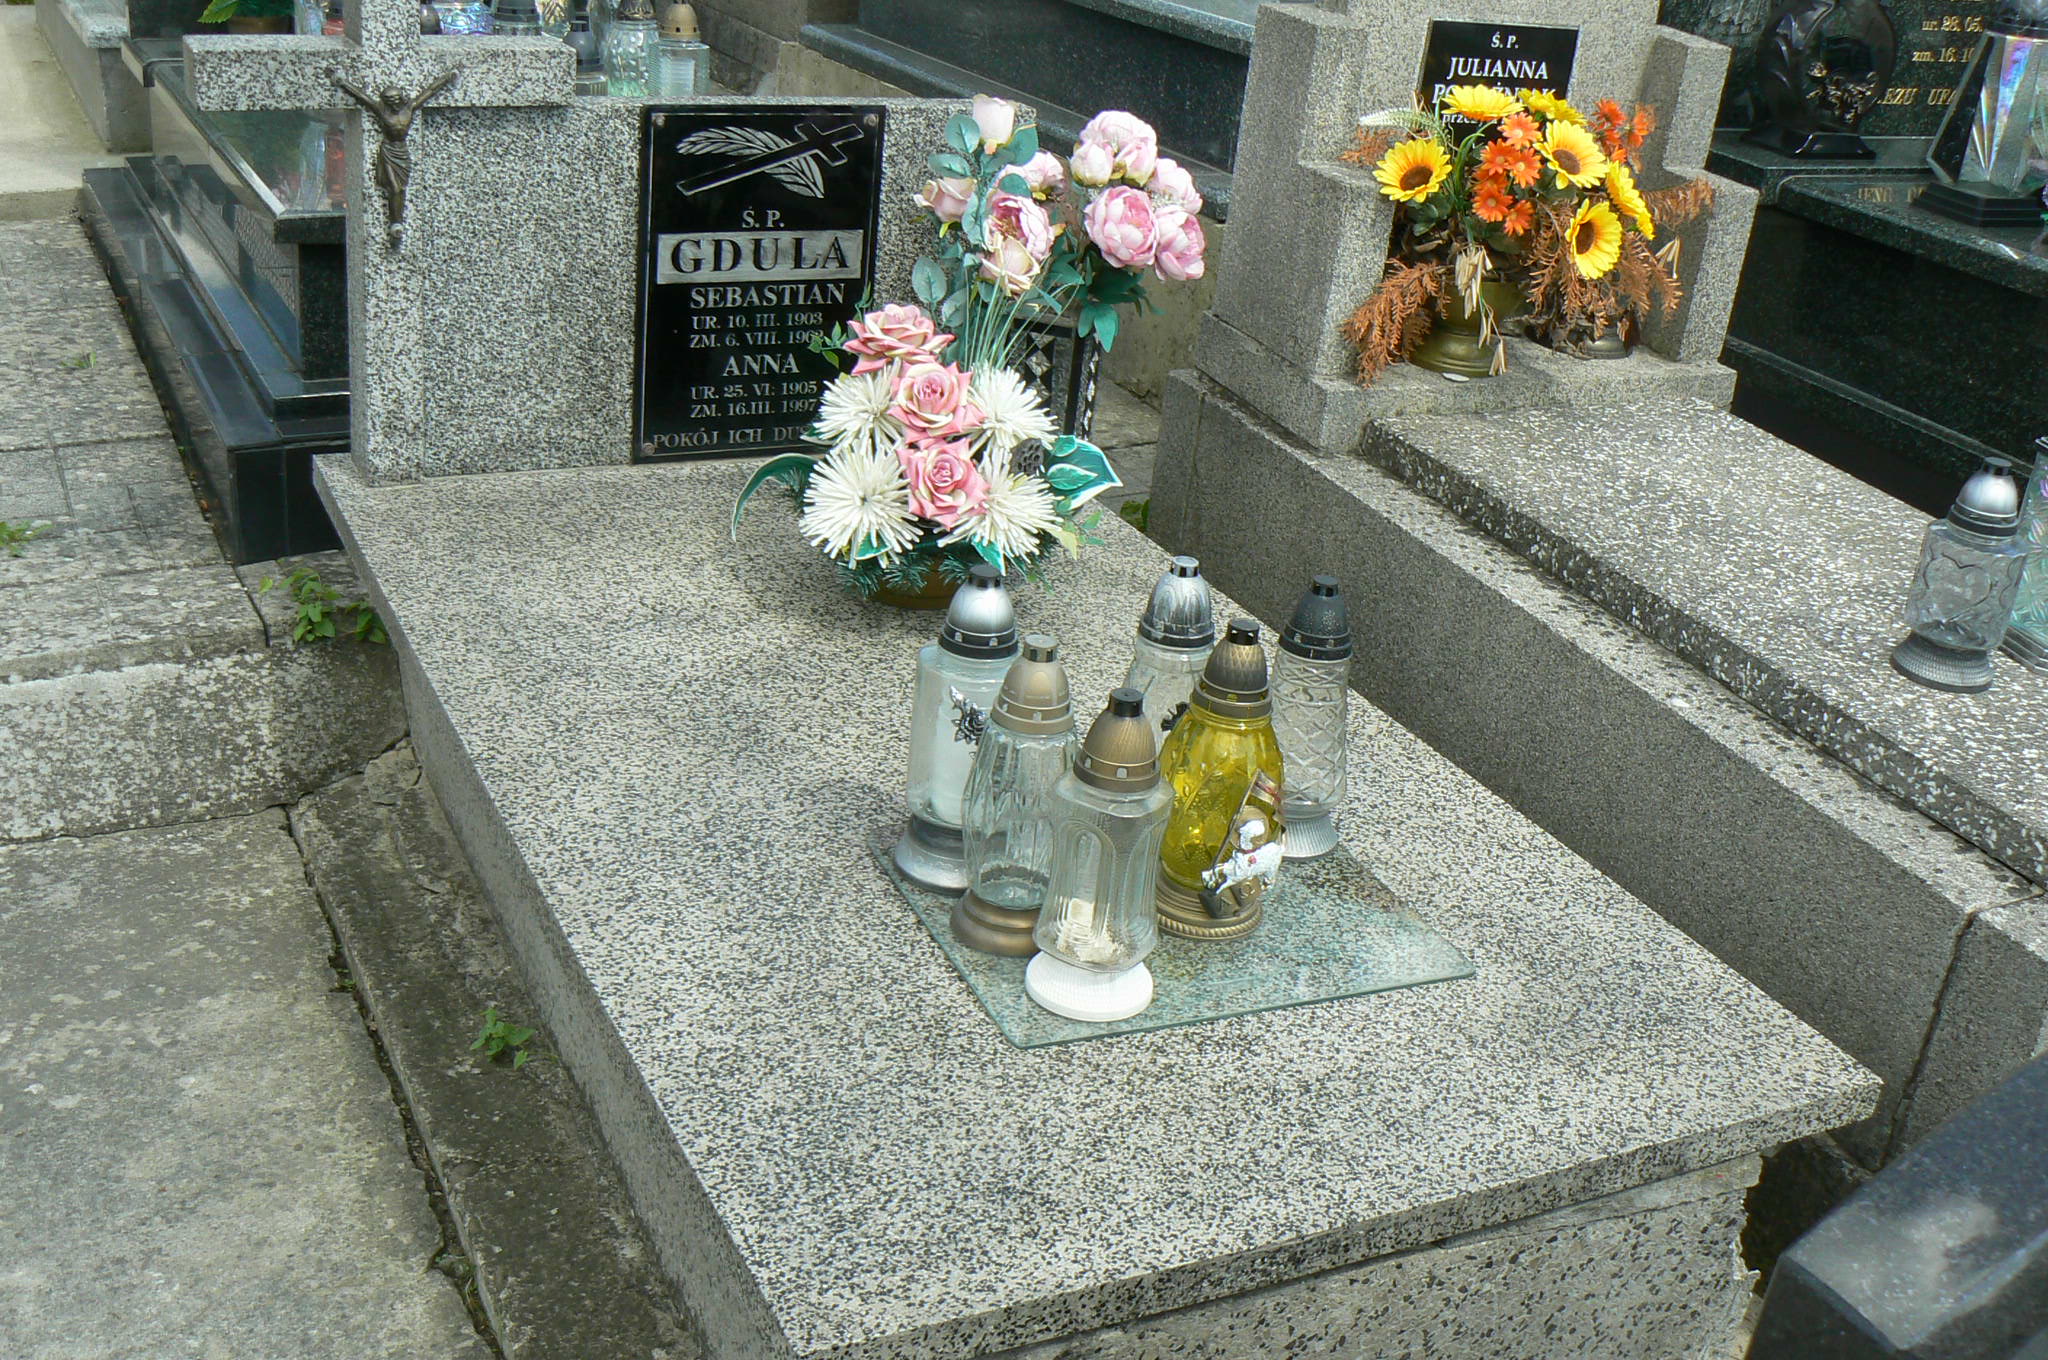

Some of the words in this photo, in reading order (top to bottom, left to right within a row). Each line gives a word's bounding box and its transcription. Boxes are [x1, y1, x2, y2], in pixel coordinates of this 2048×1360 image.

[1507, 35, 1519, 49] P.
[1446, 57, 1549, 80] JULIANNA
[1877, 88, 1919, 105] EZU
[766, 209, 785, 228] P.
[670, 236, 850, 274] GDULA
[690, 283, 845, 309] SEBASTIAN
[691, 315, 720, 330] UR.
[727, 314, 749, 328] 10.
[755, 313, 780, 327] III.
[786, 311, 823, 327] 1903
[689, 333, 720, 349] ZM.
[725, 333, 740, 347] 6.
[745, 331, 781, 345] VIII.
[722, 352, 800, 377] ANNA
[690, 386, 719, 400] UR.
[723, 384, 748, 398] 25.
[781, 380, 818, 396] 1905
[690, 403, 722, 419] ZM.
[781, 399, 818, 413] 1997
[653, 427, 719, 448] POKÓJ
[729, 428, 763, 444] ICH
